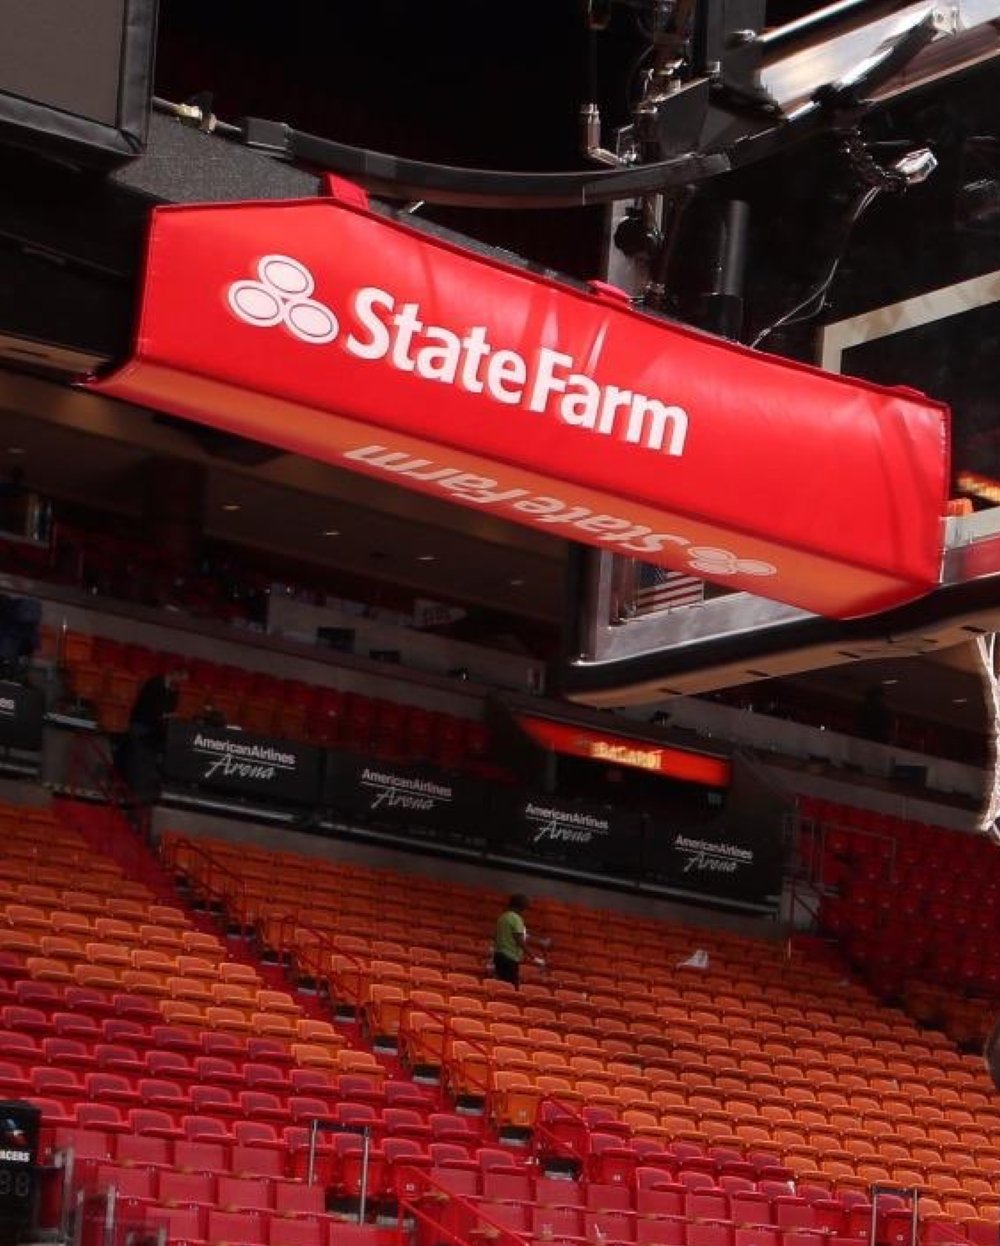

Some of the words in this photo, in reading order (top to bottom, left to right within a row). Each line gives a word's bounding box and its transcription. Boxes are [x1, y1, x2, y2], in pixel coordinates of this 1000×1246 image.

[204, 753, 276, 779] Arena
[371, 787, 435, 810] Arena
[533, 821, 593, 843] Arena
[683, 851, 737, 872] Arena
